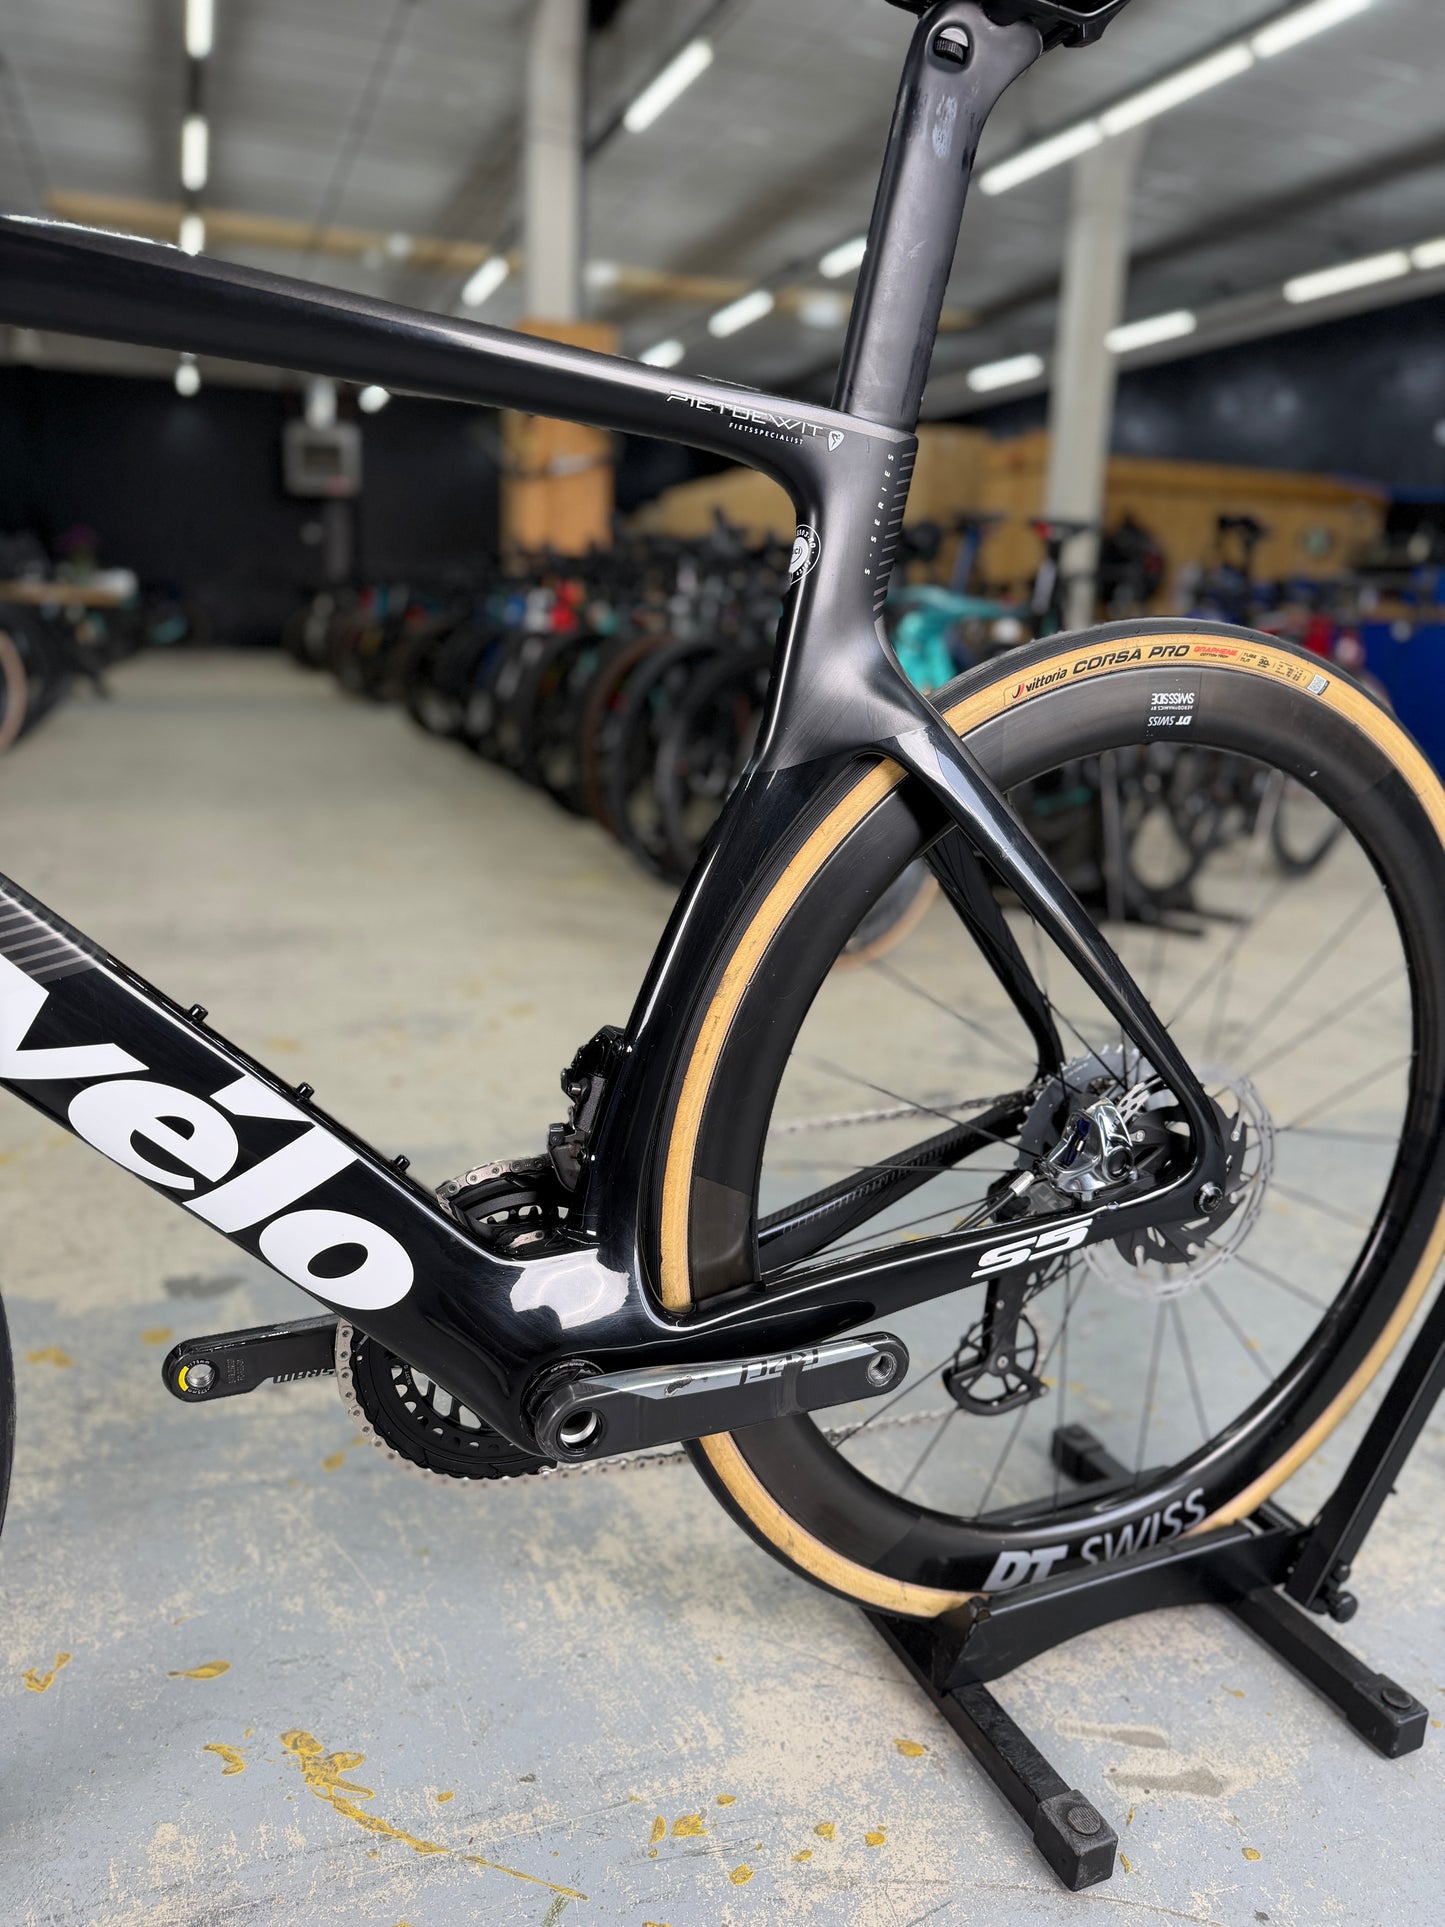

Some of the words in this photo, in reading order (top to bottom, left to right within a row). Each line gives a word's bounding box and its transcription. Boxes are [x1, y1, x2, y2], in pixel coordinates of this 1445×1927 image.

[729, 421, 804, 445] FIETSSPECIALIST
[1025, 667, 1068, 692] vittoria
[1072, 648, 1142, 675] CORSA
[1148, 644, 1191, 659] PRO
[1193, 645, 1239, 657] GRAPHENE
[1147, 715, 1176, 727] SWISS
[1175, 715, 1193, 726] DT
[971, 1218, 1093, 1279] S5
[982, 1545, 1069, 1592] DT
[1081, 1488, 1206, 1566] SWISS
